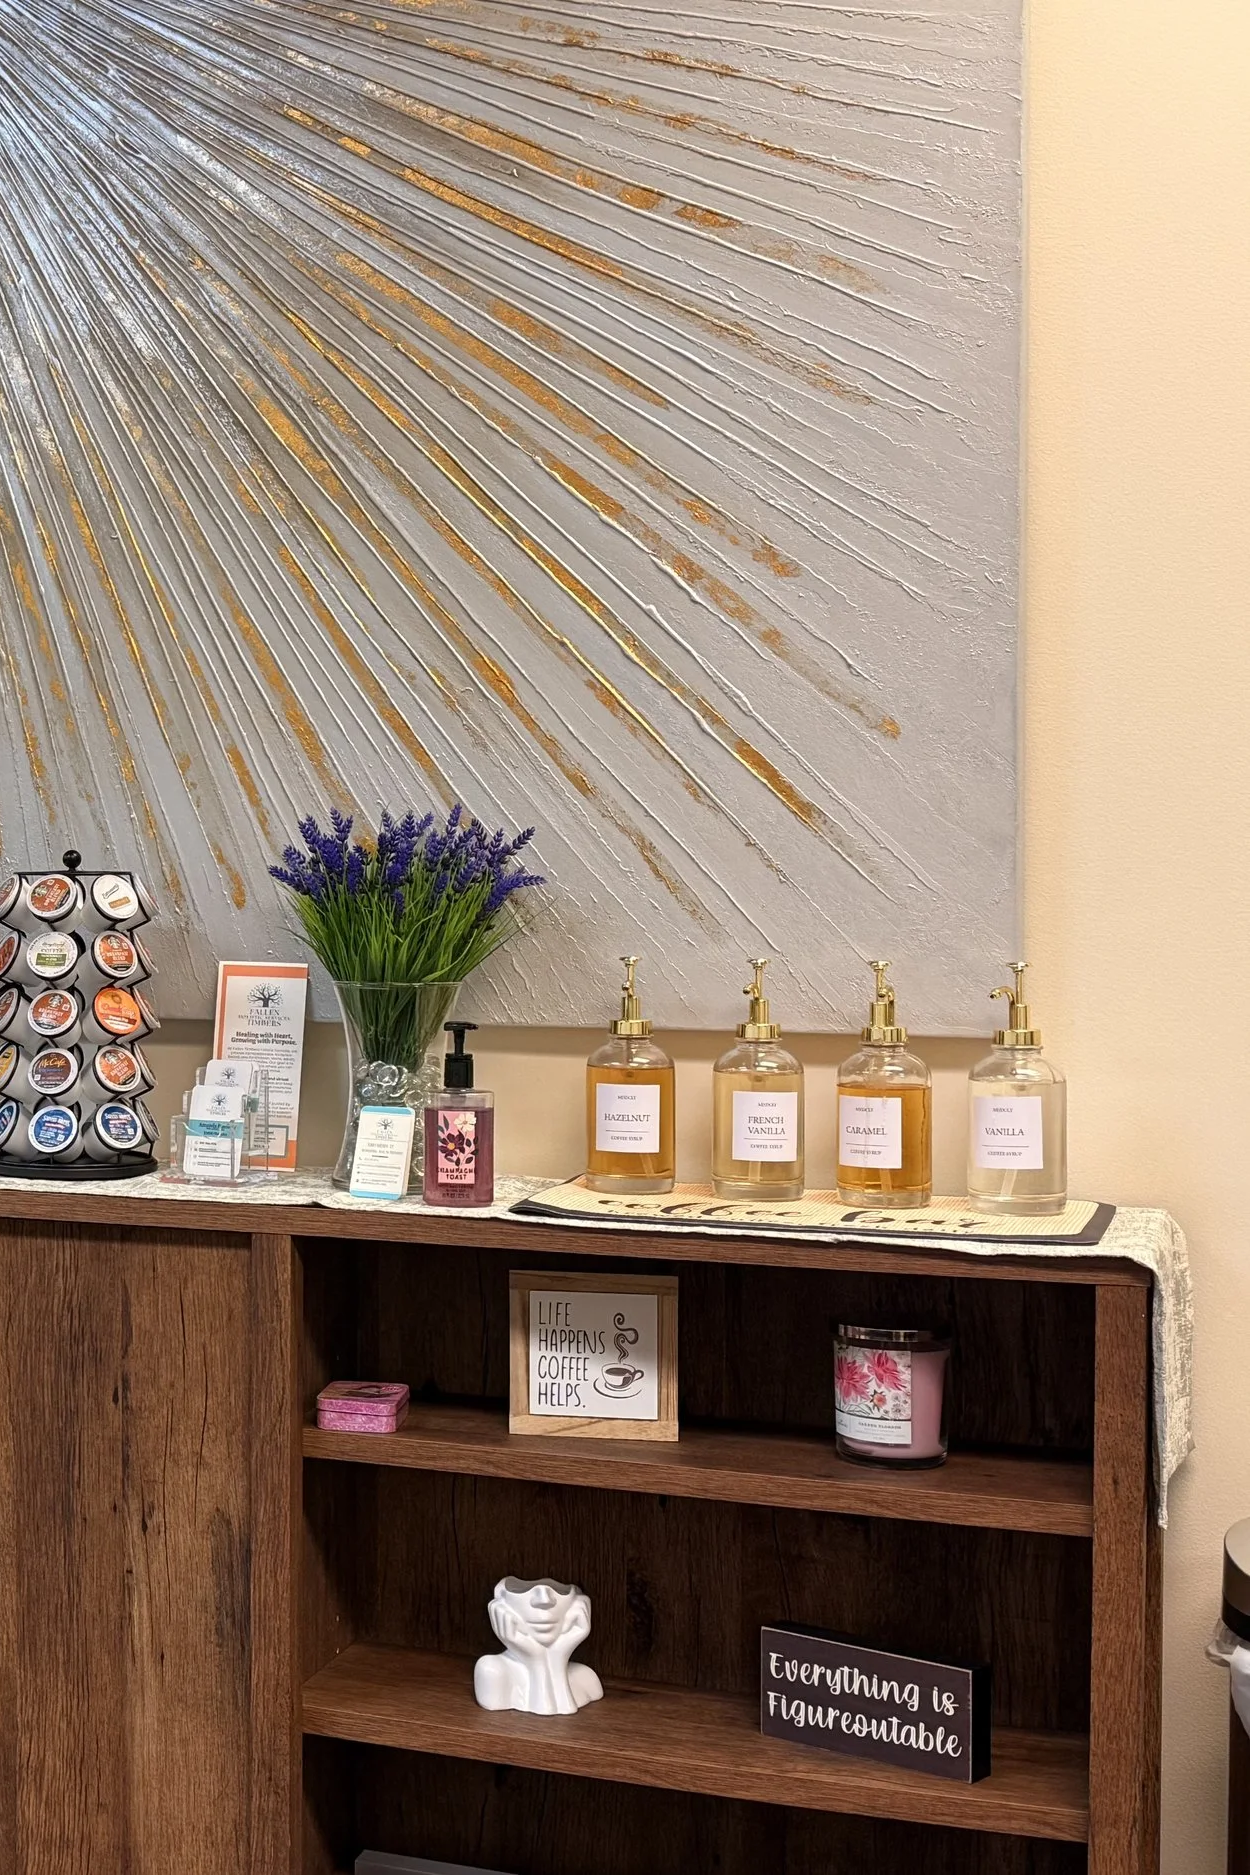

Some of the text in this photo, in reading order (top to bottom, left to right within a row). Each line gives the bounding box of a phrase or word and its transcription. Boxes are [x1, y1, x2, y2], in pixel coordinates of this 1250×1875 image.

[247, 1019, 282, 1027] TIMBERS
[236, 1031, 259, 1039] Healing
[274, 1032, 293, 1040] Heart,
[604, 1113, 651, 1123] HAZELNUT
[748, 1116, 784, 1125] FRENCH
[747, 1126, 786, 1135] VANILLA
[845, 1125, 888, 1136] CARAMEL
[984, 1127, 1025, 1136] VANILLA
[538, 1301, 572, 1326] LIFE
[538, 1328, 606, 1355] HAPPENS
[538, 1355, 590, 1381] COFFEE
[538, 1382, 586, 1408] HELPS.
[769, 1652, 960, 1716] Everything is
[767, 1691, 962, 1758] Figureoutable
